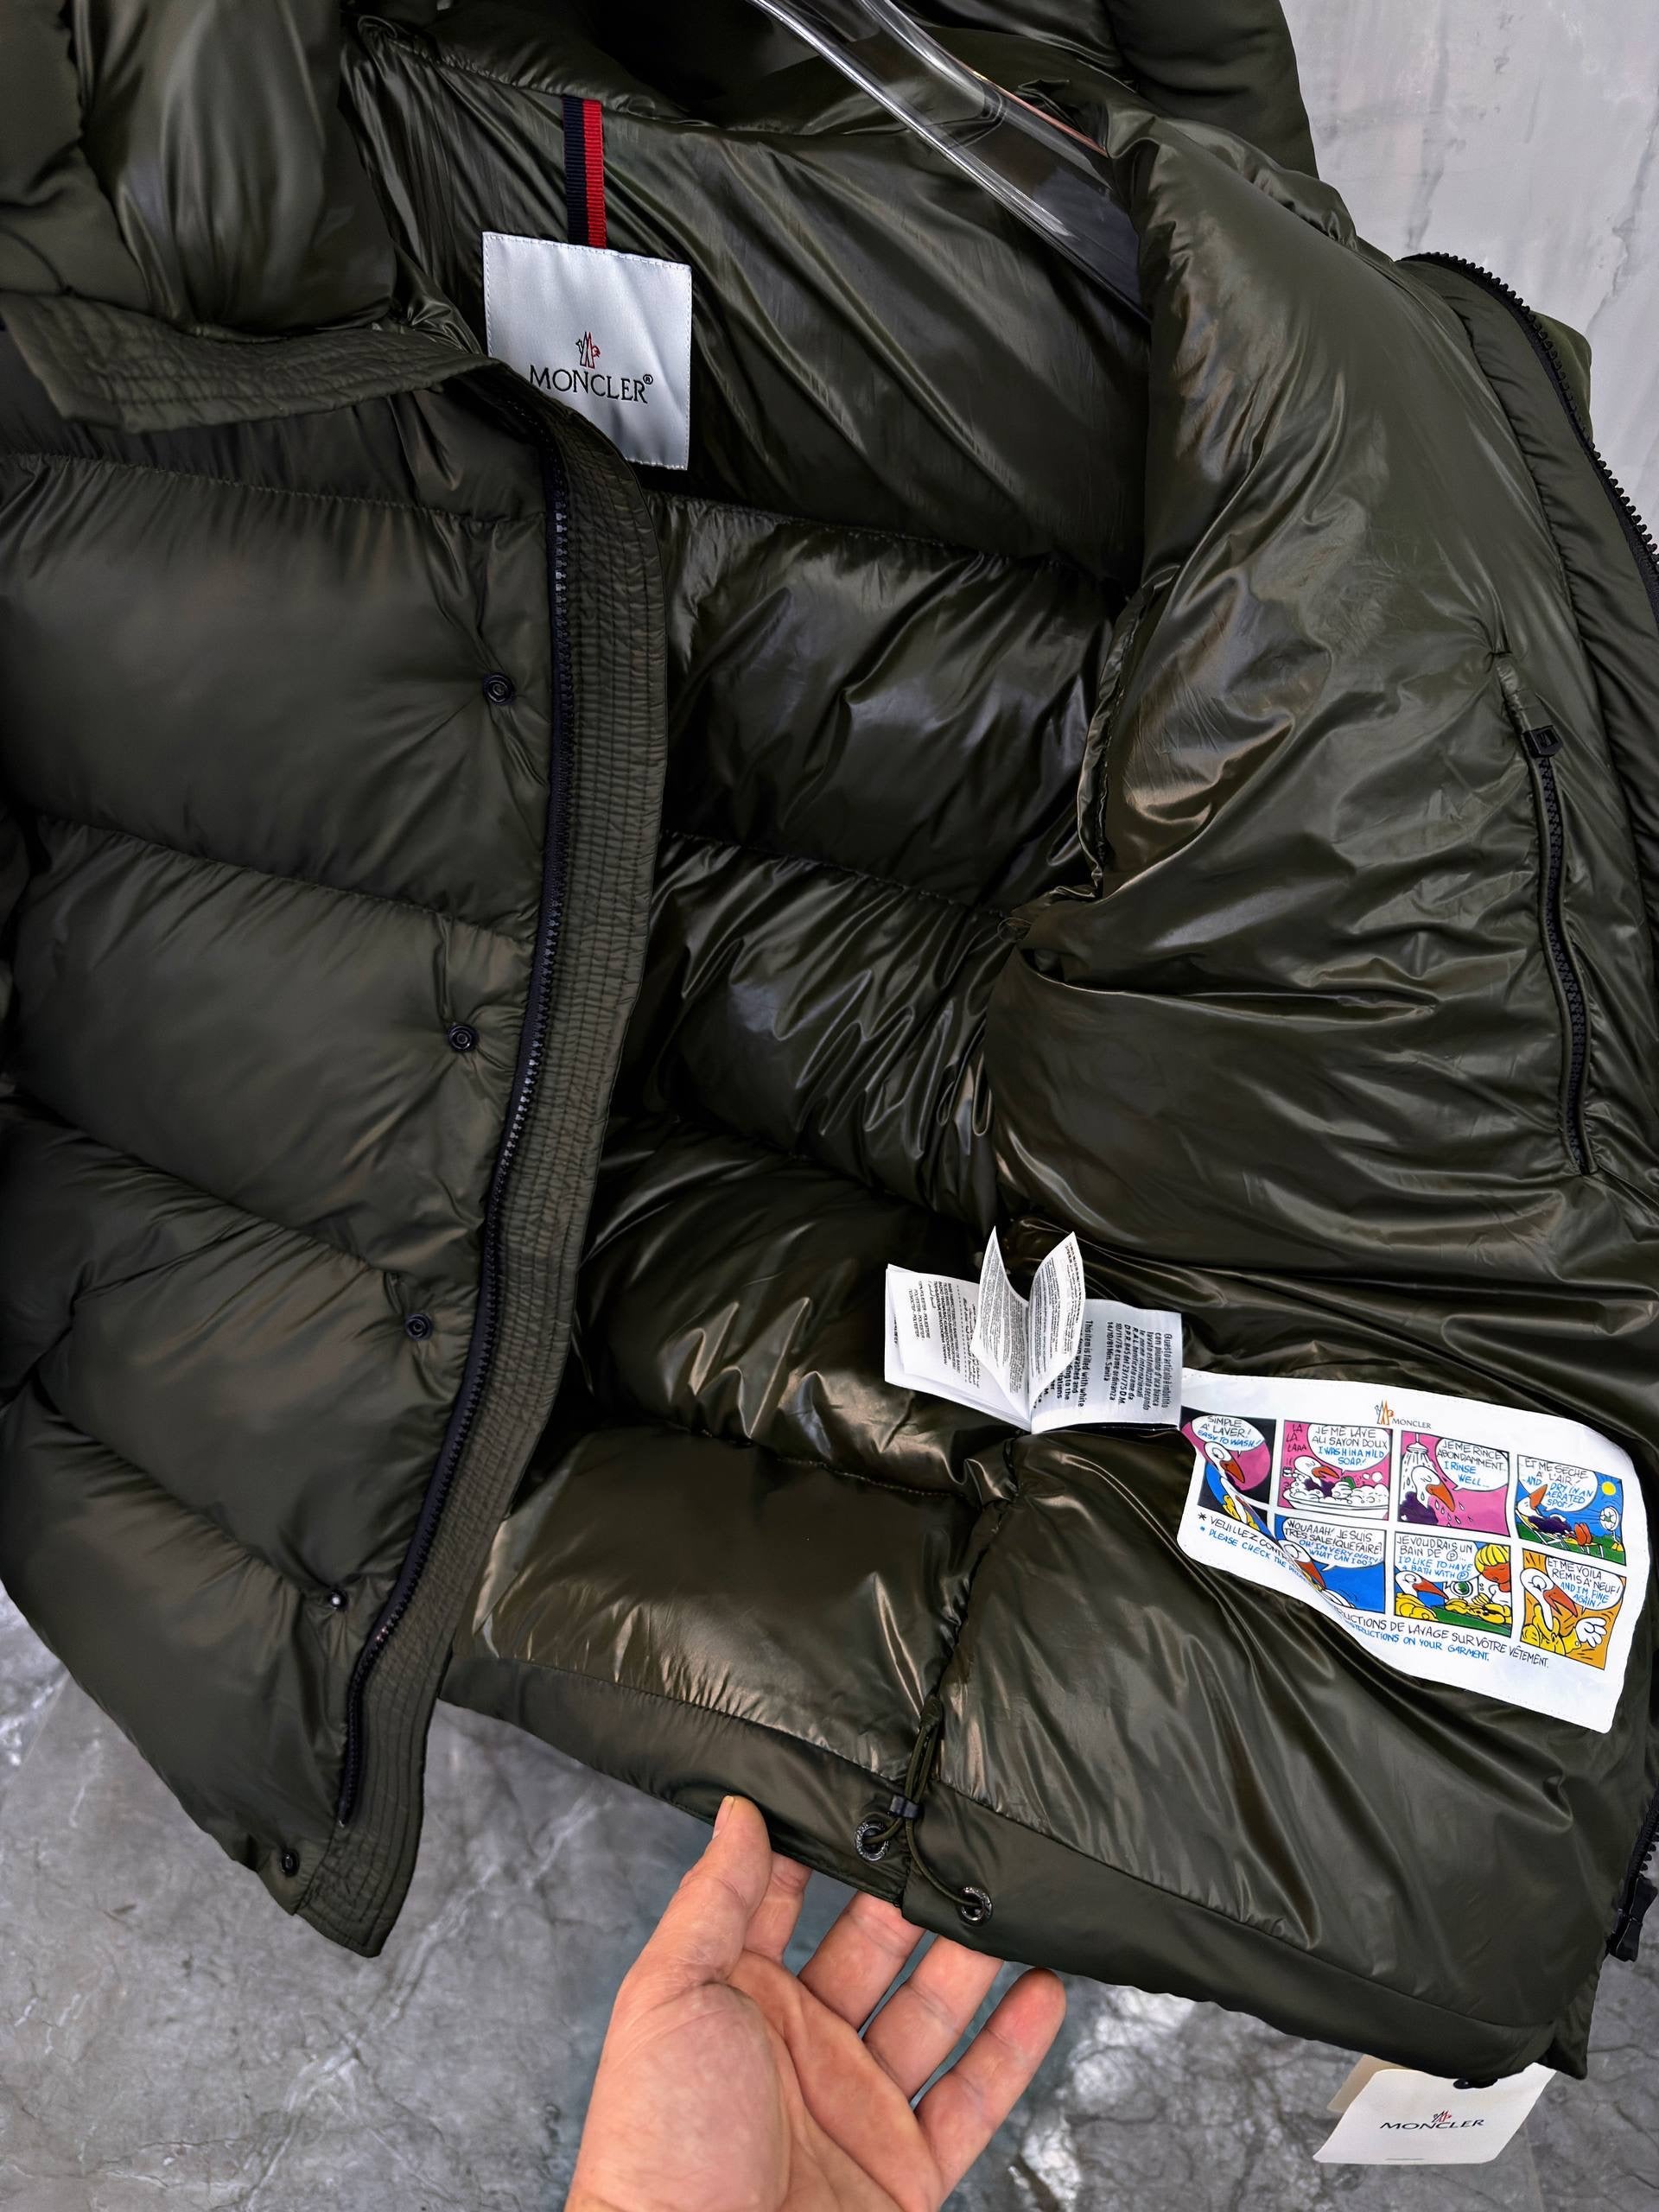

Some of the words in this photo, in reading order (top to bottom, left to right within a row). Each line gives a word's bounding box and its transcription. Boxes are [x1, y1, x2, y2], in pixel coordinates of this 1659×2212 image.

[1072, 1355, 1081, 1380] washed
[1083, 1354, 1093, 1370] filled
[1080, 1371, 1090, 1387] with
[1078, 1388, 1088, 1407] white
[1208, 1415, 1243, 1428] SIMPLE
[1392, 1418, 1432, 1429] MONCLER
[1293, 1424, 1303, 1433] LA
[1351, 1427, 1376, 1439] LAVE
[1197, 1429, 1217, 1441] EASY
[1219, 1436, 1229, 1445] TO
[1230, 1439, 1262, 1448] WASH!
[1362, 1438, 1388, 1450] DOUX
[1365, 1450, 1384, 1459] MILD
[1472, 1446, 1502, 1459] RINCE
[1451, 1461, 1477, 1474] RINSE
[1550, 1483, 1567, 1492] DRY
[1546, 1491, 1586, 1504] AERATED
[1349, 1530, 1373, 1542] SUIS
[1309, 1549, 1332, 1560] WHAT
[1333, 1554, 1349, 1562] CAN
[1329, 1547, 1353, 1557] VERY
[1400, 1545, 1423, 1555] BAIN
[1427, 1548, 1441, 1558] DE
[1459, 1545, 1472, 1554] UN
[1411, 1565, 1432, 1575] BATH
[1413, 1557, 1433, 1567] LIKE
[1448, 1563, 1473, 1572] HAVE
[1560, 1561, 1574, 1572] ME
[1211, 1516, 1259, 1541] VEUILLEZ
[1390, 1622, 1405, 1632] DE
[1452, 1632, 1474, 1645] SUR
[1552, 1568, 1582, 1585] REMIS
[1209, 1529, 1238, 1547] PLEASE
[1242, 1541, 1270, 1559] CHECK
[1274, 1556, 1287, 1568] THE
[1403, 1637, 1416, 1646] ON
[1419, 1638, 1443, 1650] YOUR
[1560, 1582, 1575, 1592] AND
[1592, 1590, 1610, 1603] FINE
[1380, 2119, 1486, 2130] MONCLER
